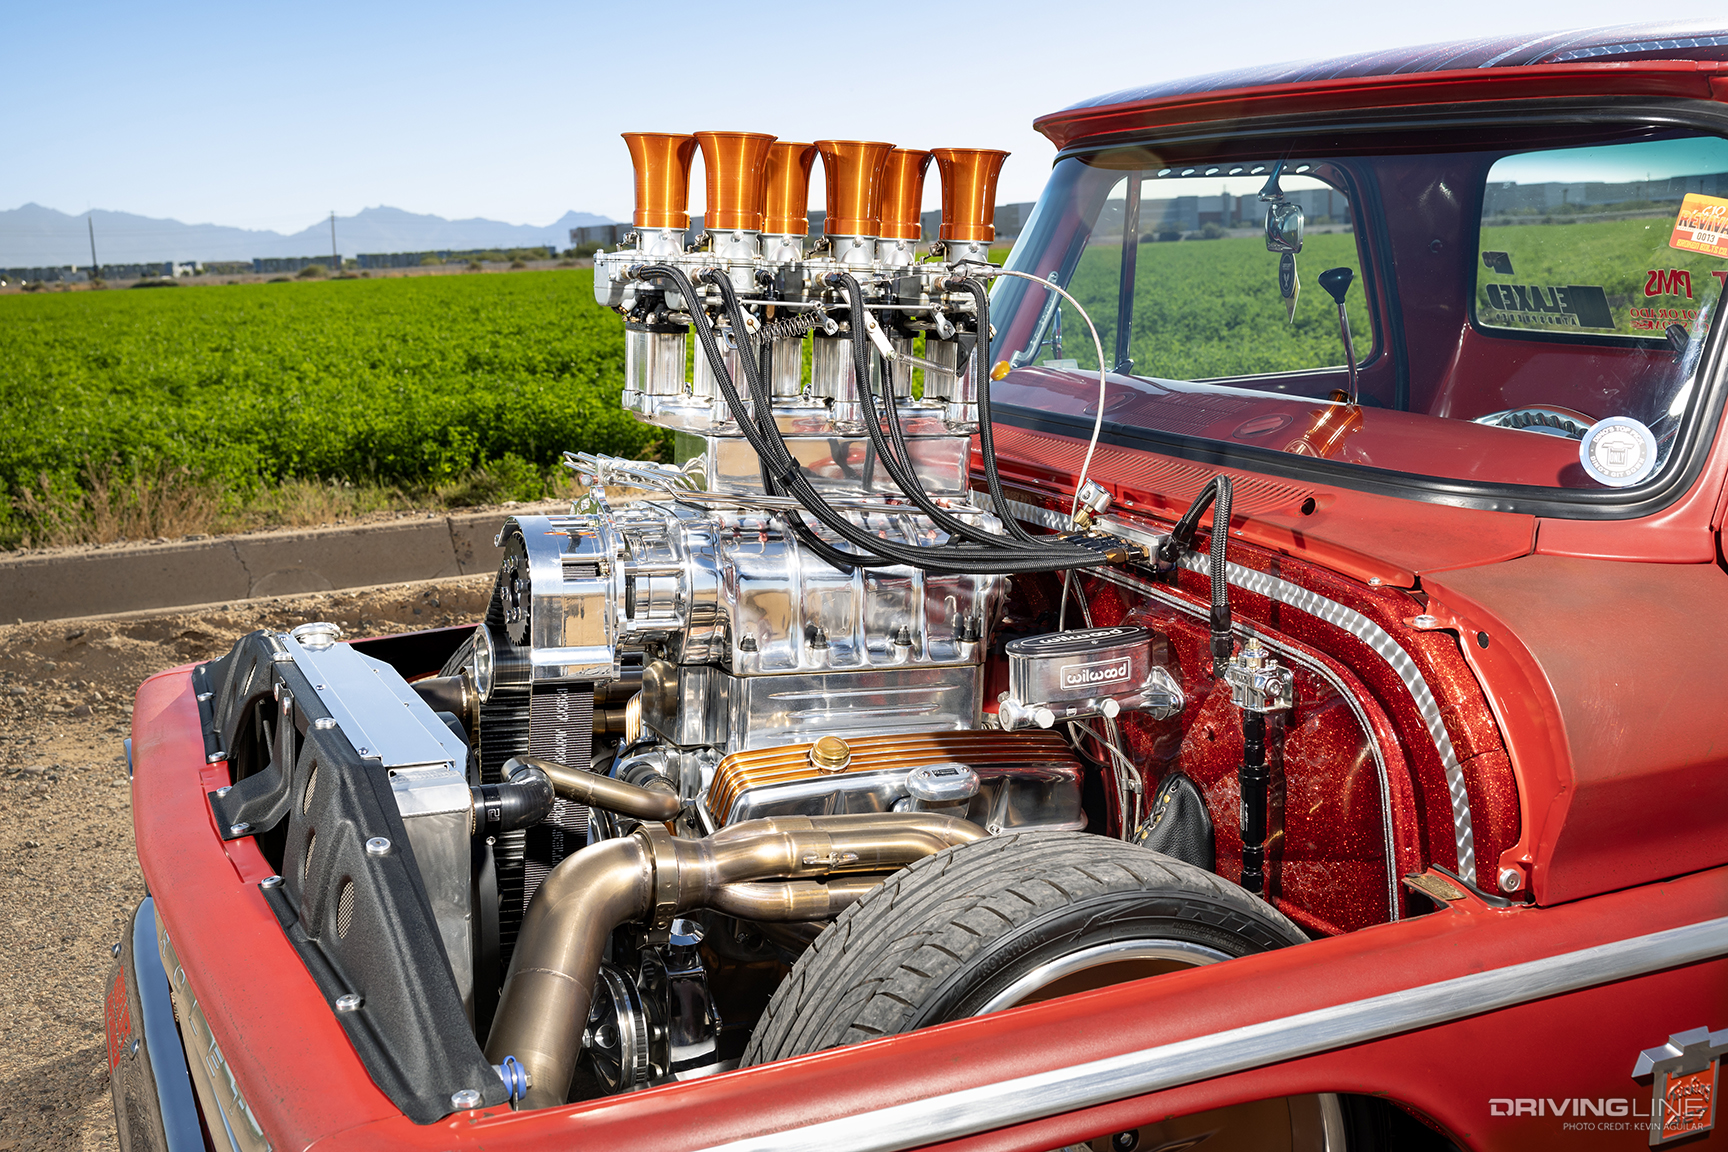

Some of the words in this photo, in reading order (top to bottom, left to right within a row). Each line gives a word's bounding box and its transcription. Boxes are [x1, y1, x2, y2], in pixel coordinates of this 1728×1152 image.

[1678, 210, 1728, 235] REVIVA
[1696, 231, 1716, 243] 0013
[1592, 426, 1615, 443] DINO'S
[1615, 425, 1631, 433] TOP
[1630, 429, 1645, 446] PICK
[1590, 456, 1609, 475] DINO'S
[1625, 458, 1645, 476] DOWN
[1609, 451, 1626, 464] ONLY
[1039, 628, 1123, 644] wilwood
[1066, 662, 1127, 684] wilwood
[981, 930, 1040, 977] ROTATION
